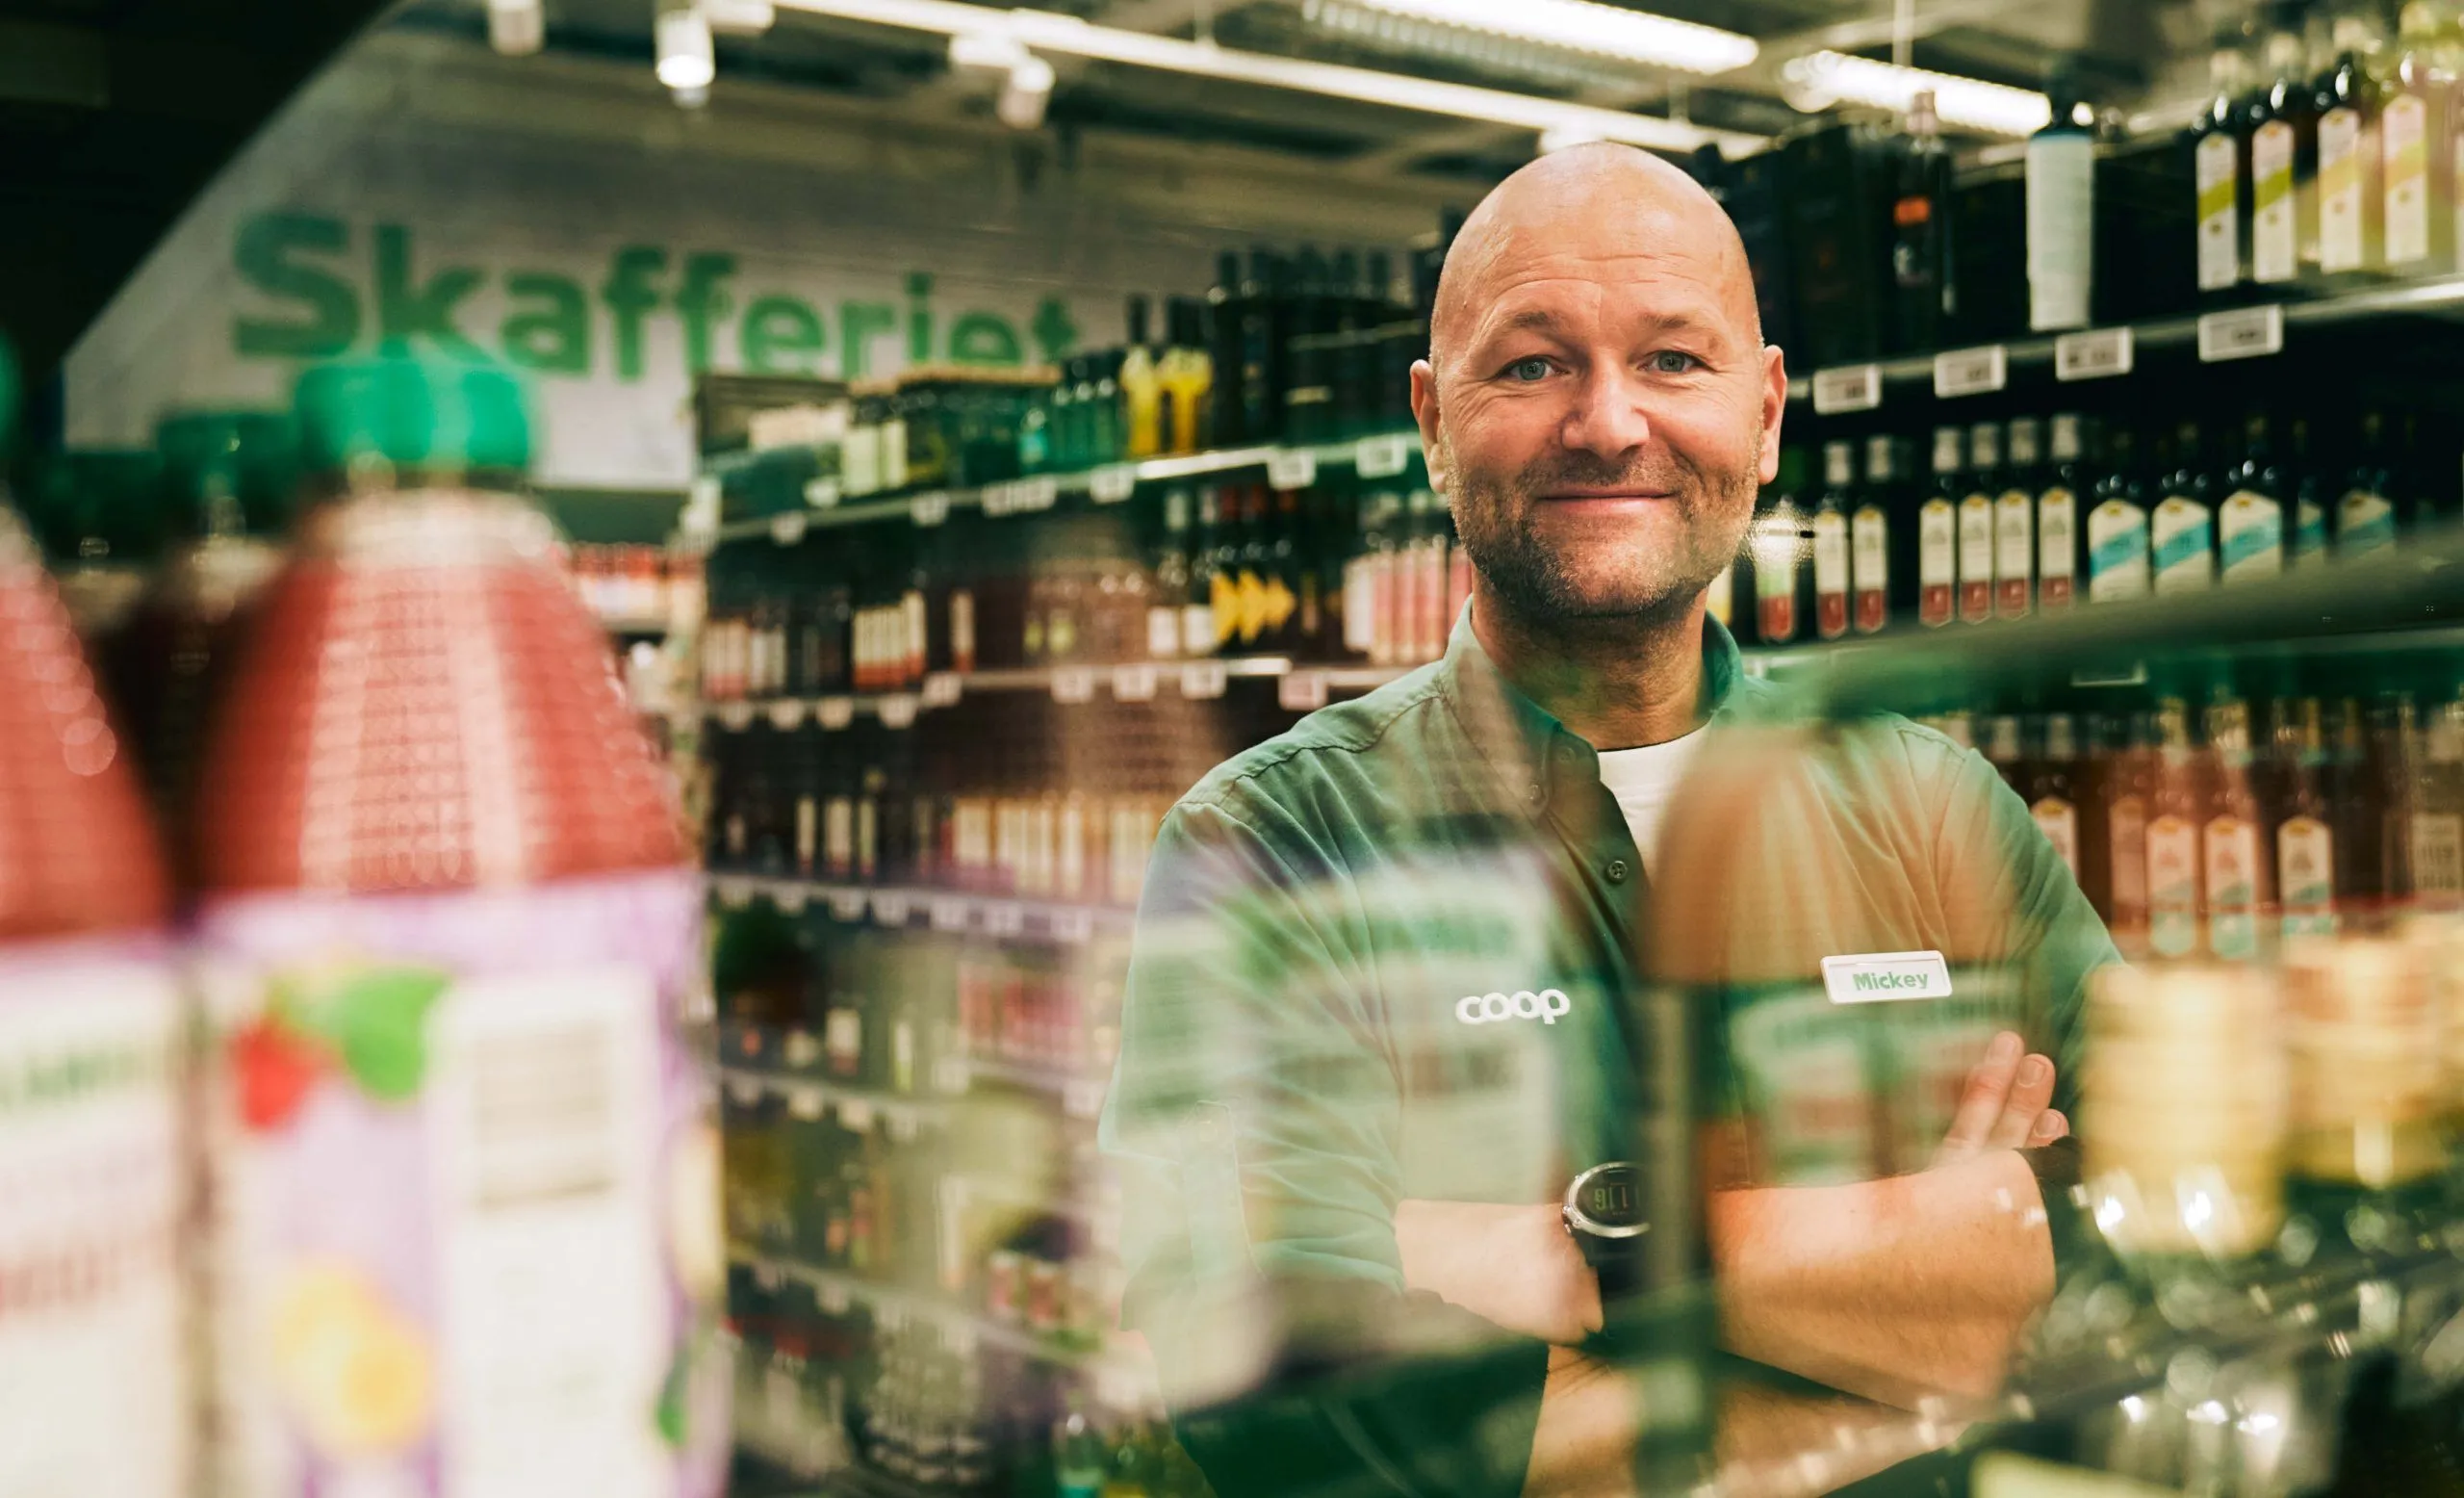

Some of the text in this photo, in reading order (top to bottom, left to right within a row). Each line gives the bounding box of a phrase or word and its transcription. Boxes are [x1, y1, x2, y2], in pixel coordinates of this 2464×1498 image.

[232, 212, 1077, 379] Skafferiet
[1853, 972, 1928, 991] Mickey
[1455, 989, 1571, 1025] coop
